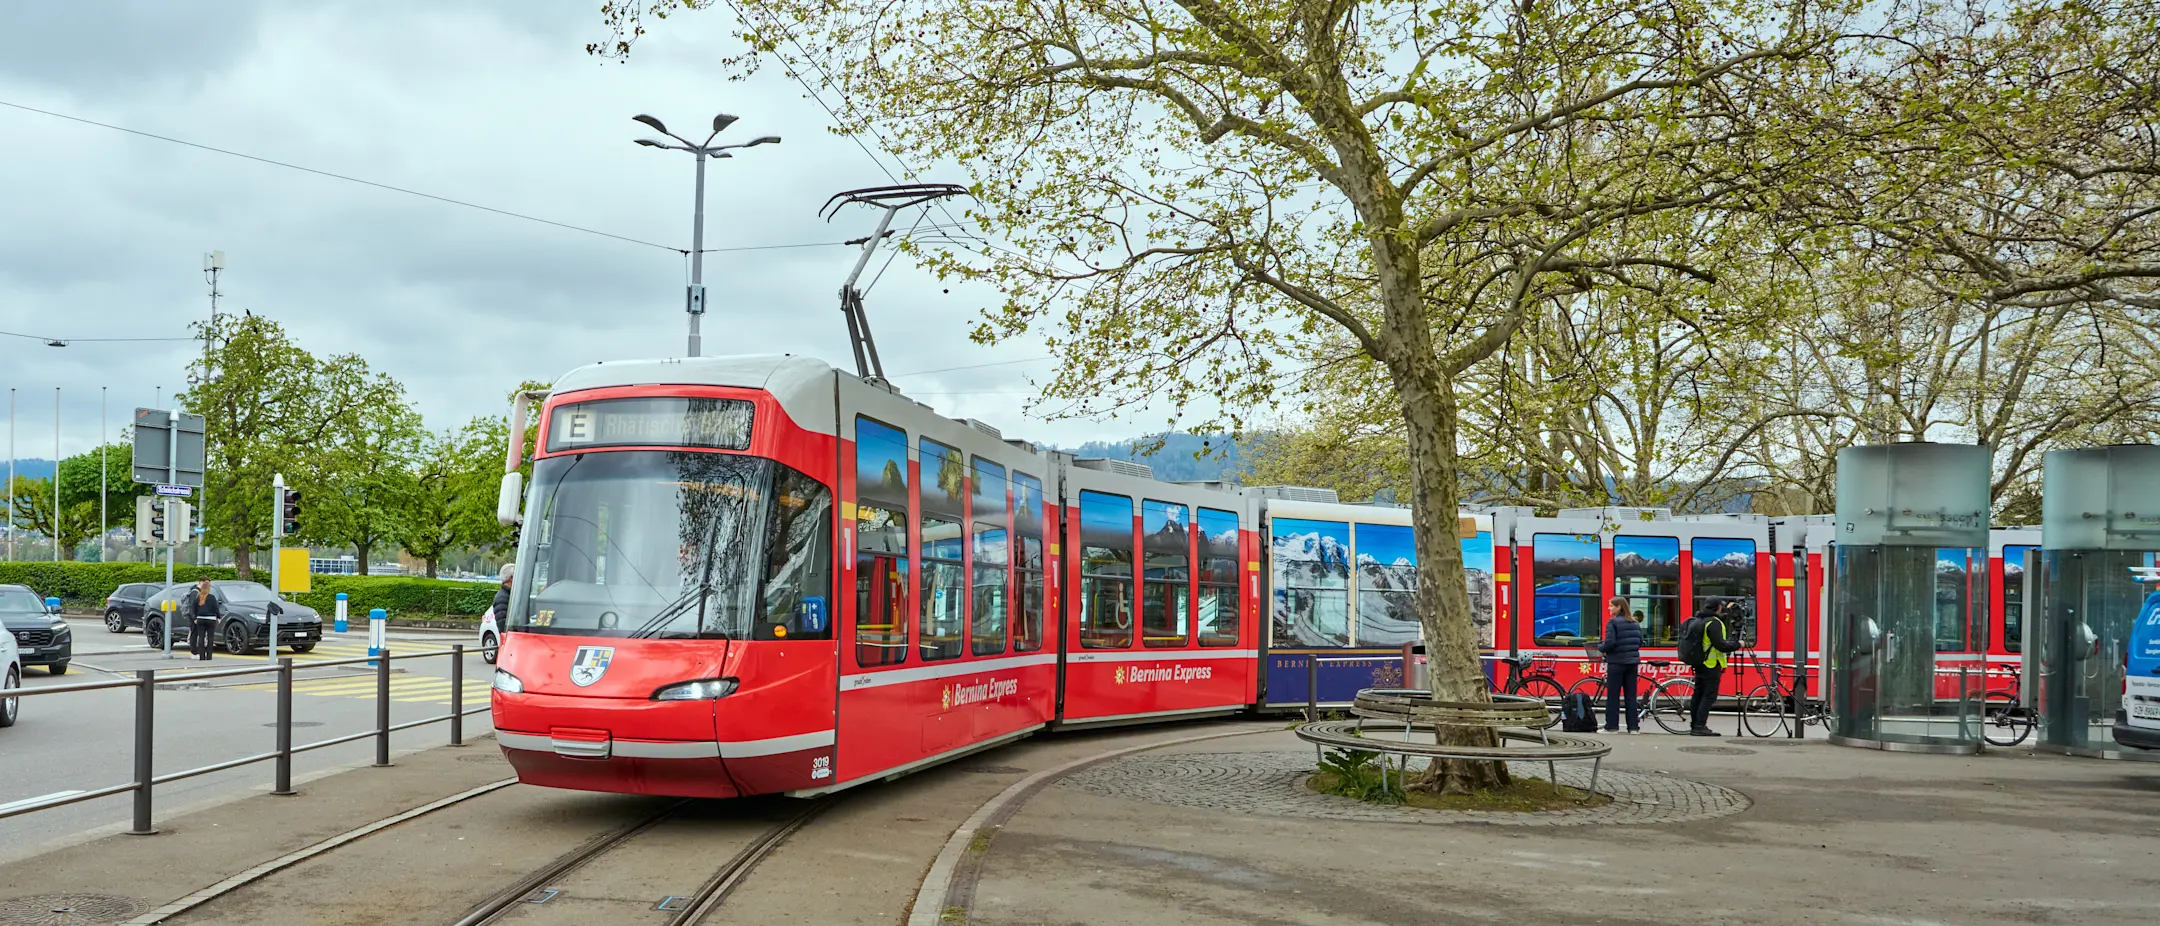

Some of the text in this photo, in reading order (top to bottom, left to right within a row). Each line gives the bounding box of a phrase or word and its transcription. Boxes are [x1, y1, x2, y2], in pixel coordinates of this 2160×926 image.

[569, 414, 587, 438] E
[844, 528, 851, 570] 1
[1052, 561, 1058, 588] 1
[1251, 575, 1258, 598] 1
[1501, 585, 1508, 605] 1
[1783, 590, 1791, 609] 1
[1130, 663, 1212, 683] Bernina Express
[1277, 660, 1323, 668] BERNIA
[1660, 664, 1696, 676] Expr
[954, 677, 1018, 706] Bernina Express
[813, 756, 829, 768] 3019
